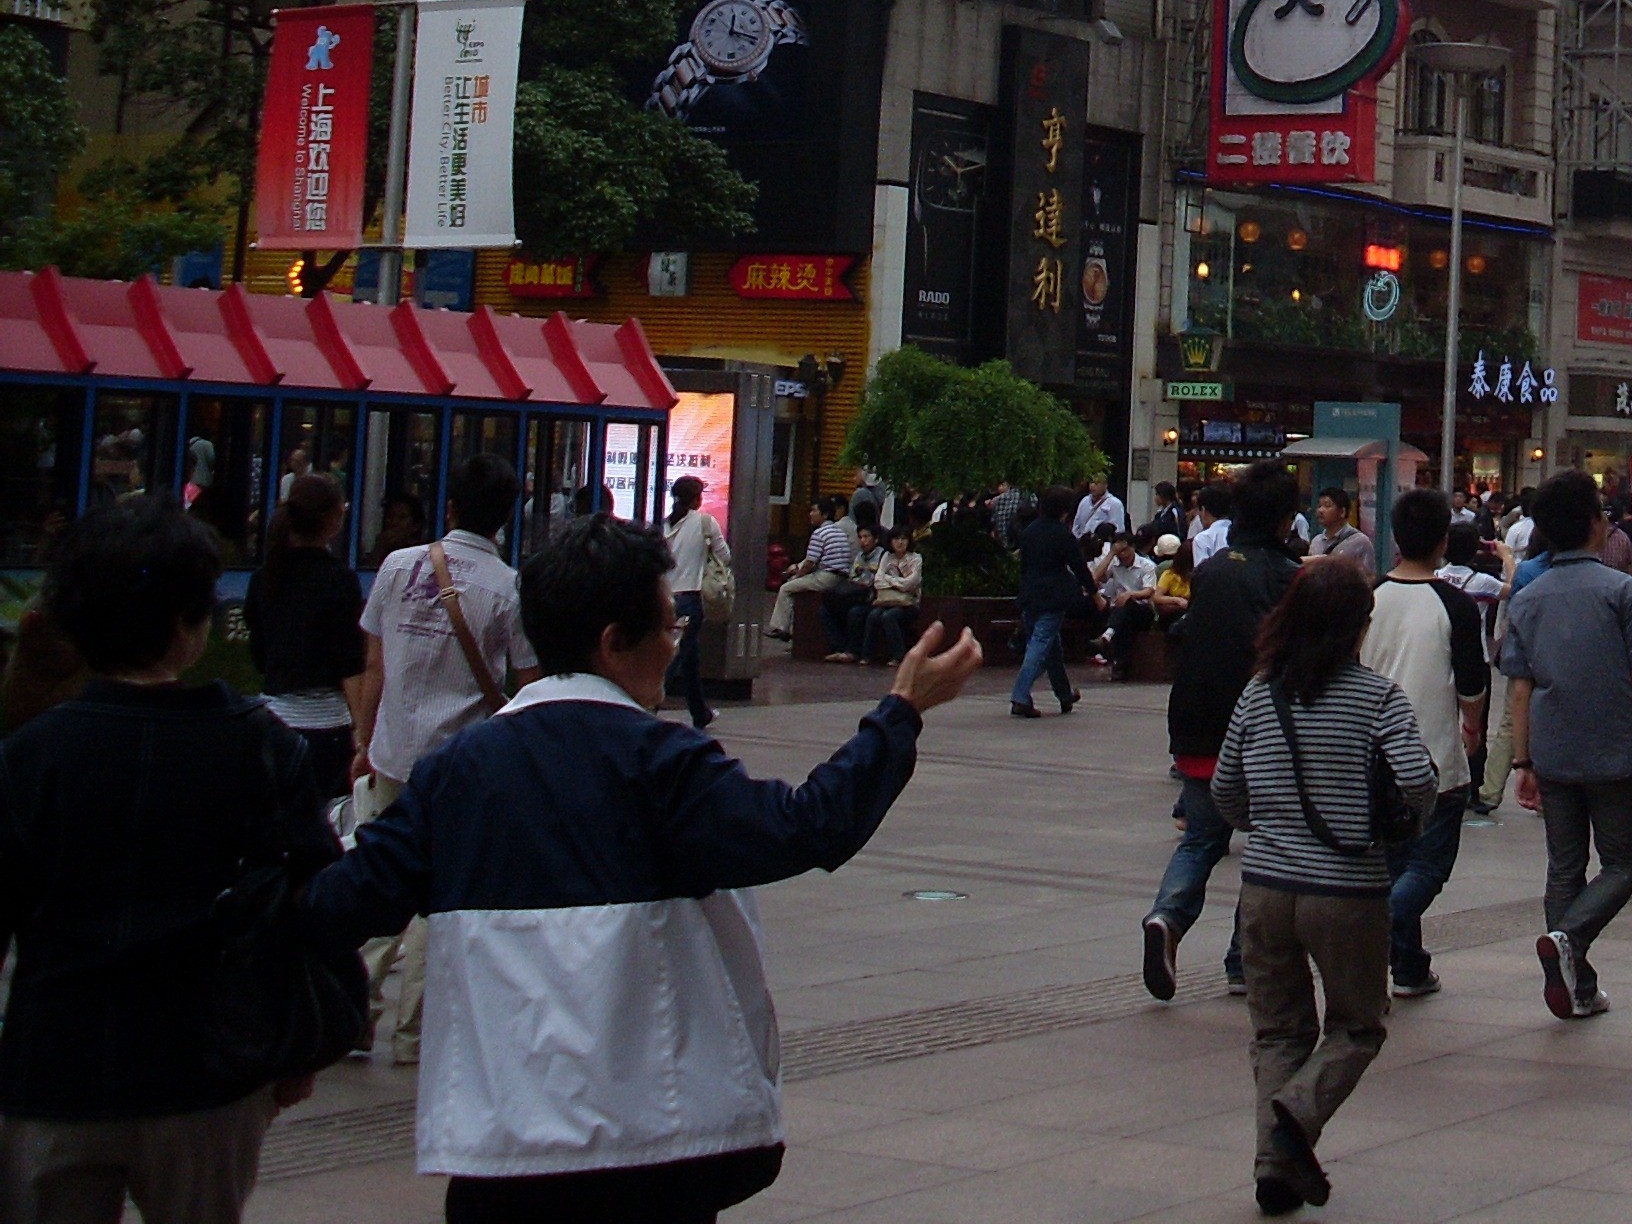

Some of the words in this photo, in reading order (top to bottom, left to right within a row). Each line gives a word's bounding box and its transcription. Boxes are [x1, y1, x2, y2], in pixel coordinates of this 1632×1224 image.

[742, 262, 819, 291] 麻辣烫
[918, 289, 950, 305] RADO
[1467, 349, 1559, 404] 泰康食品
[1170, 385, 1219, 397] ROLEX
